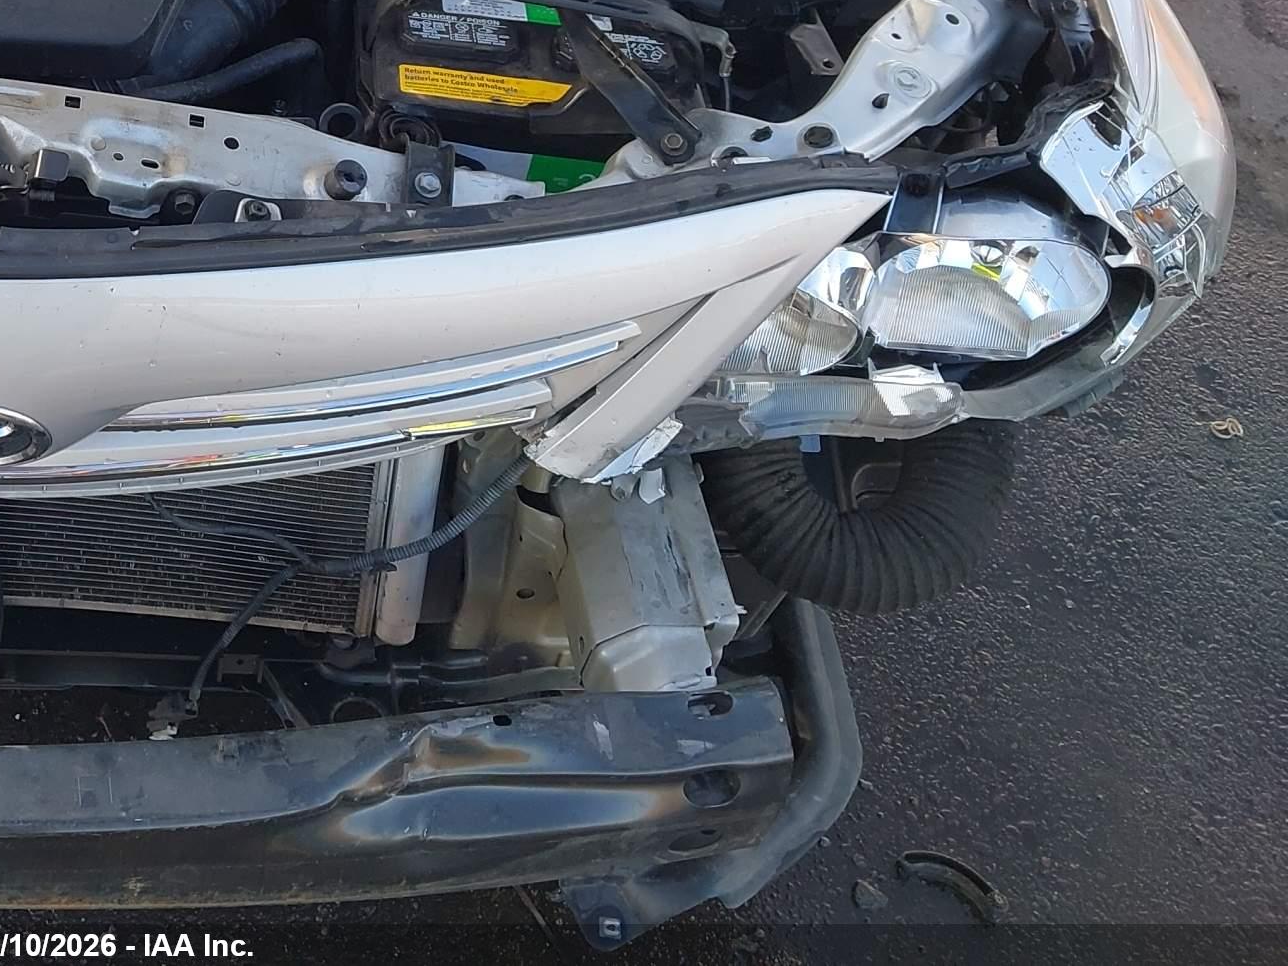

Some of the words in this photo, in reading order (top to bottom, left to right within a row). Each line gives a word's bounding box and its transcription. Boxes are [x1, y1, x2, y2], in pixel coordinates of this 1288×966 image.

[420, 12, 458, 22] DANGER
[466, 17, 501, 26] POISON
[404, 67, 431, 75] Return
[432, 72, 468, 81] warranty
[404, 75, 440, 83] batteries
[450, 79, 475, 88] Costco
[477, 82, 518, 92] Wholesale
